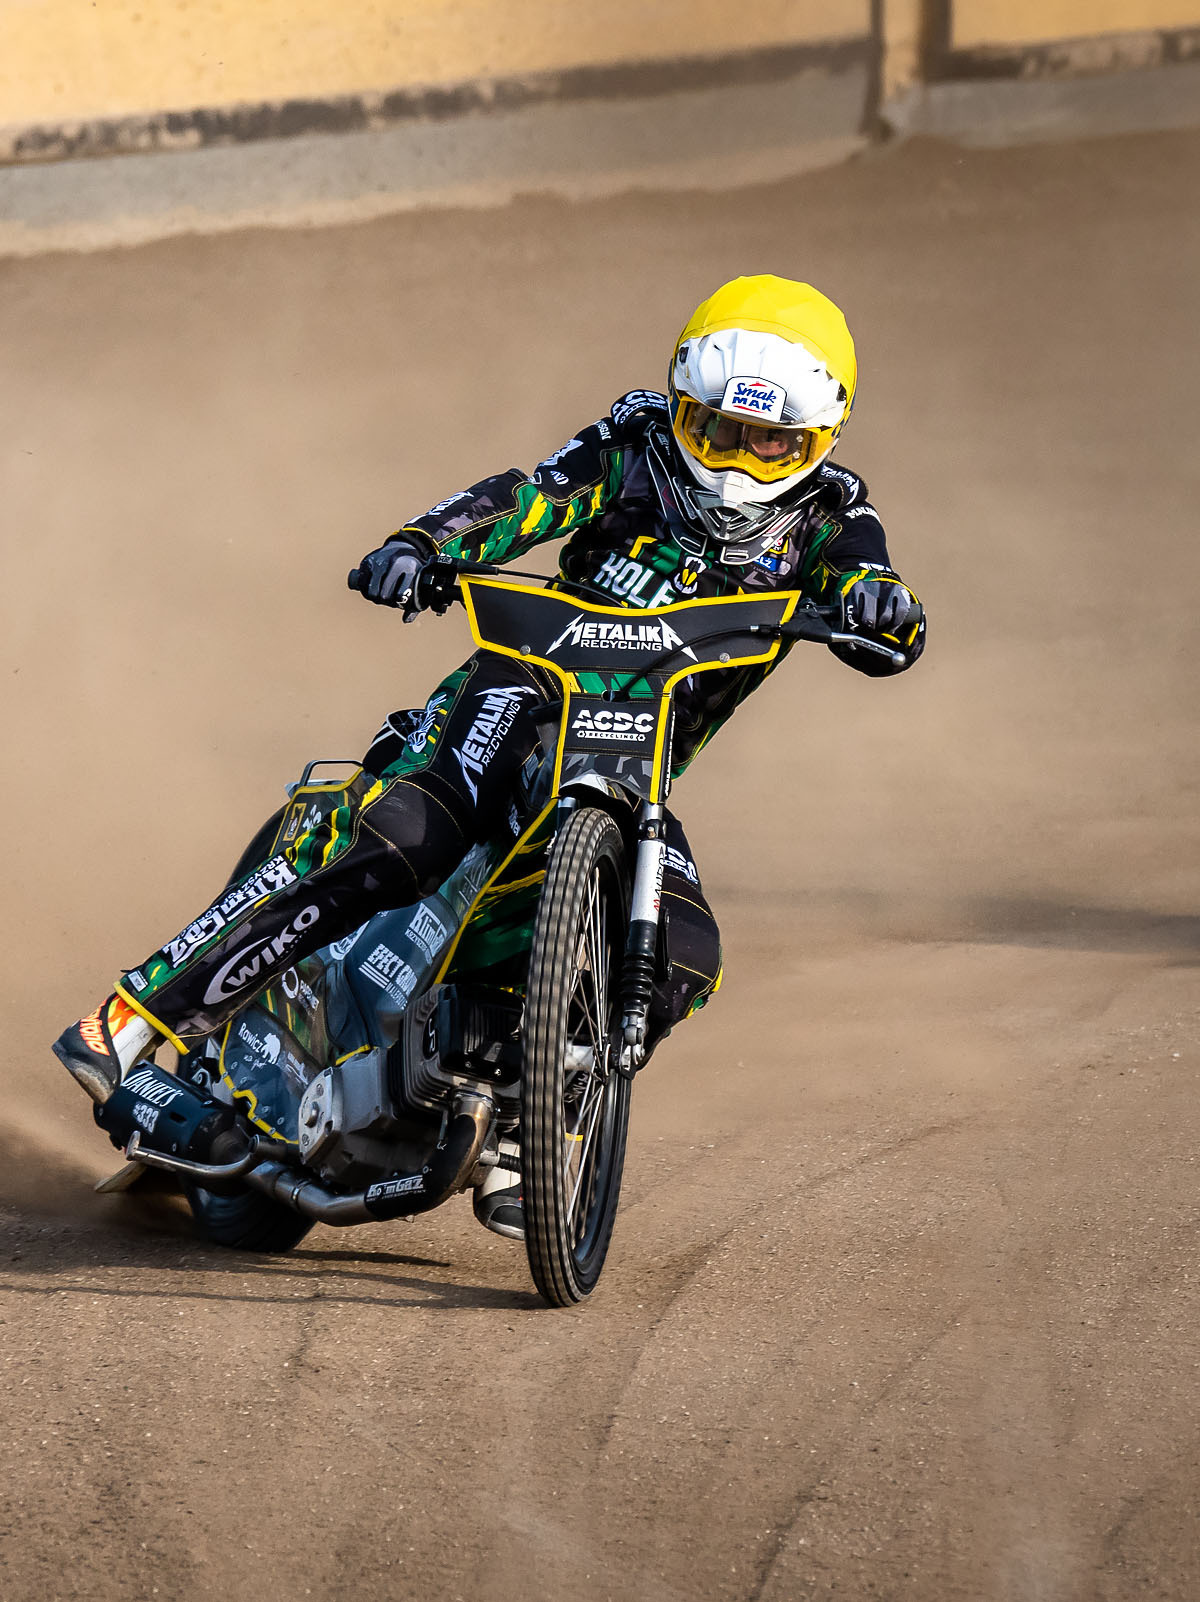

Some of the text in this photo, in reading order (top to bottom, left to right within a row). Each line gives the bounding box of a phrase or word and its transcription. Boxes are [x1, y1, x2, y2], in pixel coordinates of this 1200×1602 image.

[732, 396, 773, 412] MAK
[734, 383, 776, 403] Smak
[545, 613, 698, 662] METALIKA
[580, 640, 662, 651] RECYCLING
[481, 700, 521, 767] RECYCLING
[572, 710, 654, 733] ACDC
[588, 732, 634, 740] RECYCLING
[452, 685, 539, 808] METALIKA
[162, 861, 298, 969] KlimGaz
[225, 905, 320, 986] WIKO
[238, 1022, 263, 1053] Rawicz
[120, 1069, 184, 1107] DANIEL'S
[132, 1101, 160, 1133] #333
